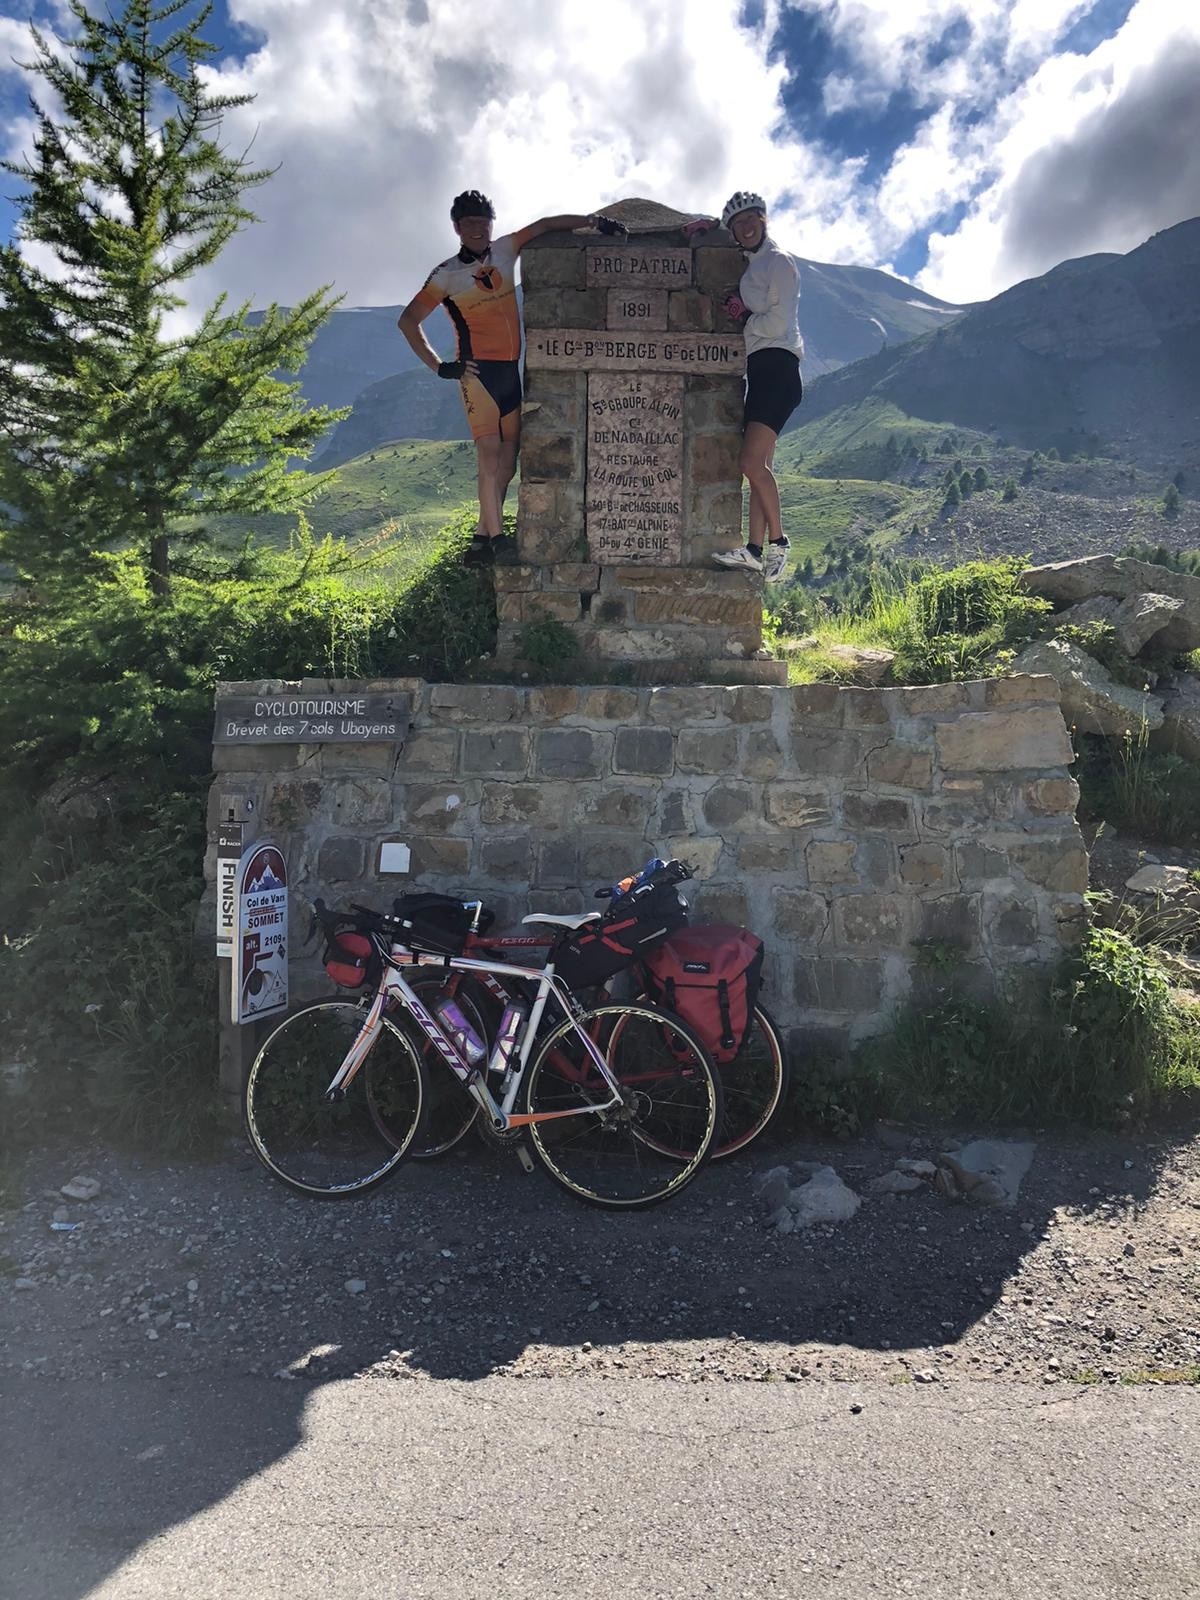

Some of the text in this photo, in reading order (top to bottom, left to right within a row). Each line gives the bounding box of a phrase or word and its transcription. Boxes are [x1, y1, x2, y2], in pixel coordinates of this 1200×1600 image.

[593, 257, 689, 274] PRO PATRIA
[623, 302, 650, 317] 1891
[546, 340, 559, 356] LE
[605, 341, 657, 360] BERGE
[681, 349, 695, 361] DE
[697, 345, 728, 362] LYON
[629, 383, 641, 392] LE
[608, 396, 648, 412] GROUPE
[648, 400, 680, 420] ALPIN
[594, 430, 679, 445] DE NADAILLAC
[606, 454, 659, 467] RESTAURE
[593, 466, 678, 488] LA ROUTE DU COL
[628, 500, 680, 514] CHASSEURS
[637, 519, 669, 532] ALPINE
[254, 700, 366, 717] CYCLOTOURISME
[226, 721, 396, 739] Brevet des 7 cols Ubayens
[222, 863, 237, 928] FINISH
[246, 897, 259, 908] Col
[260, 896, 269, 906] de
[247, 912, 285, 929] SOMMET
[264, 934, 282, 947] 2109
